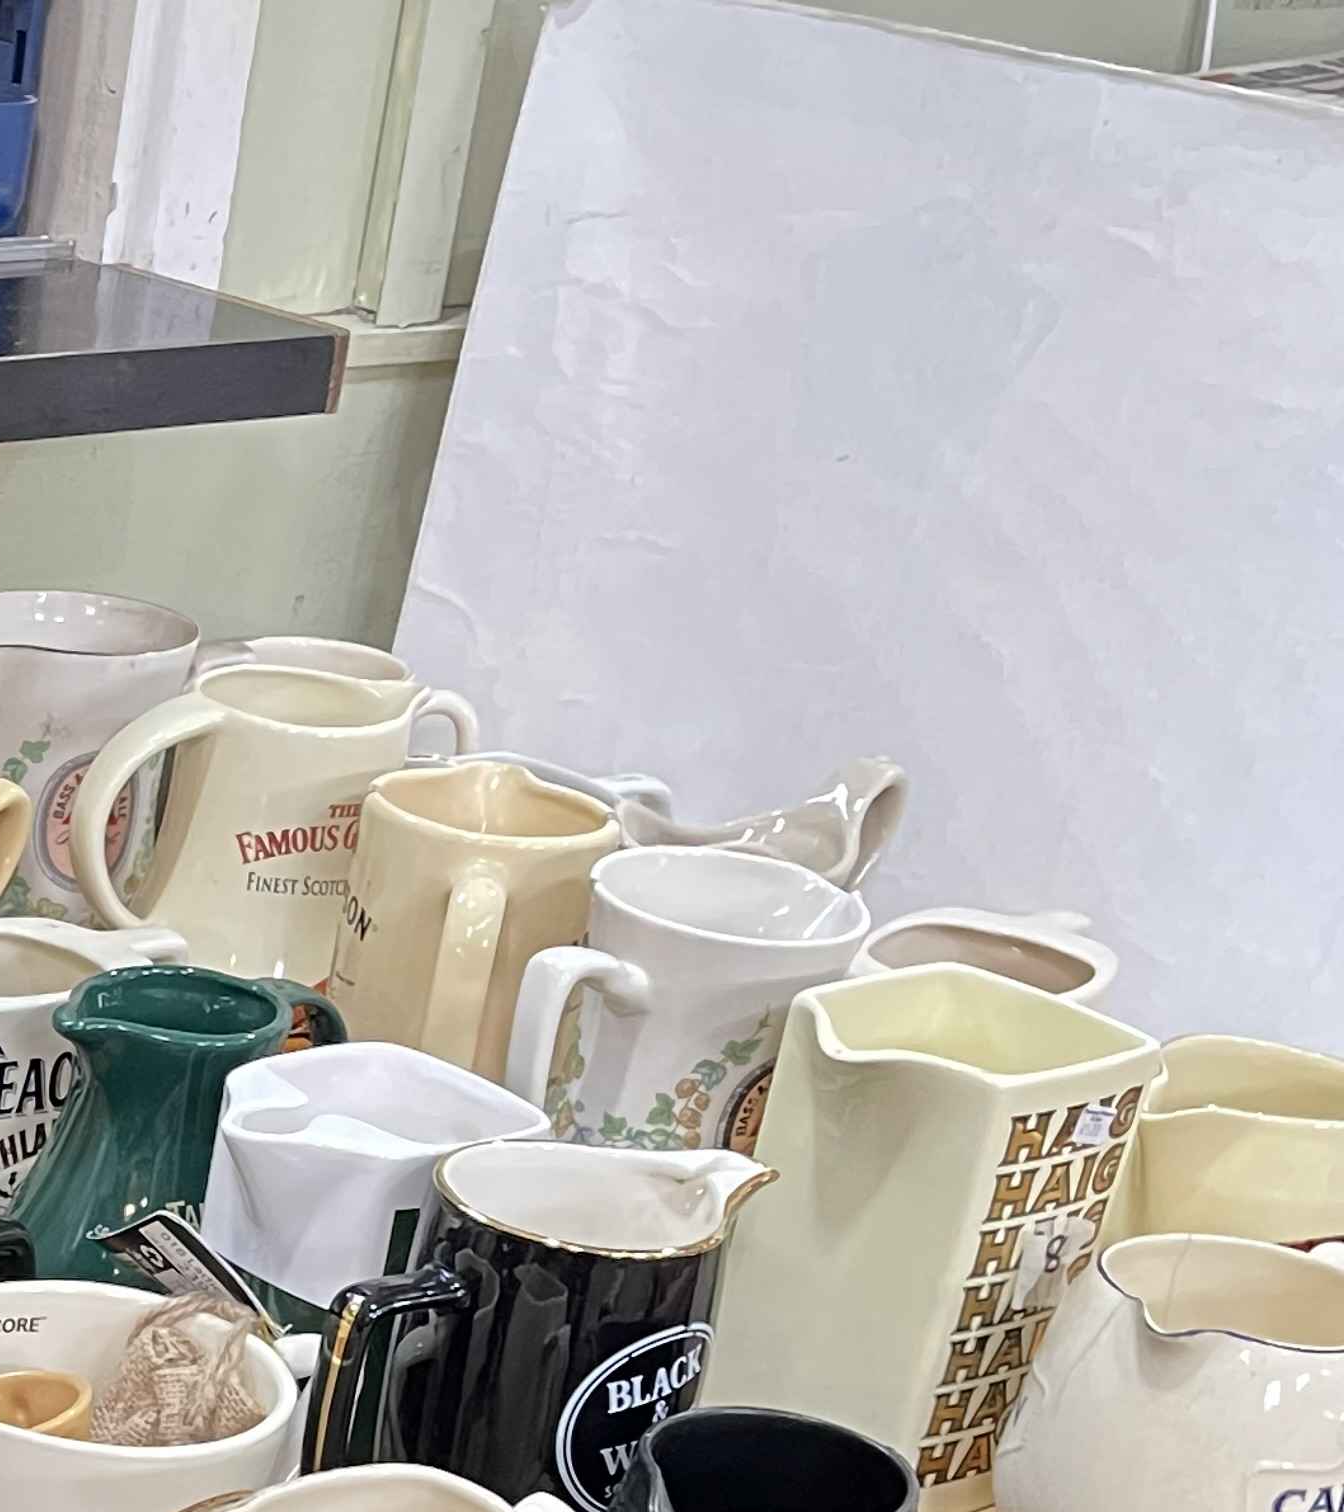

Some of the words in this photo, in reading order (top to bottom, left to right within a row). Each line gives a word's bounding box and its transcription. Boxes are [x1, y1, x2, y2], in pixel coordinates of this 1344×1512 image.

[235, 824, 341, 866] FAMOUS
[246, 871, 299, 896] FINEST
[982, 1141, 1127, 1225] HAIG
[164, 1200, 201, 1234] TA
[606, 1343, 703, 1415] BLACK
